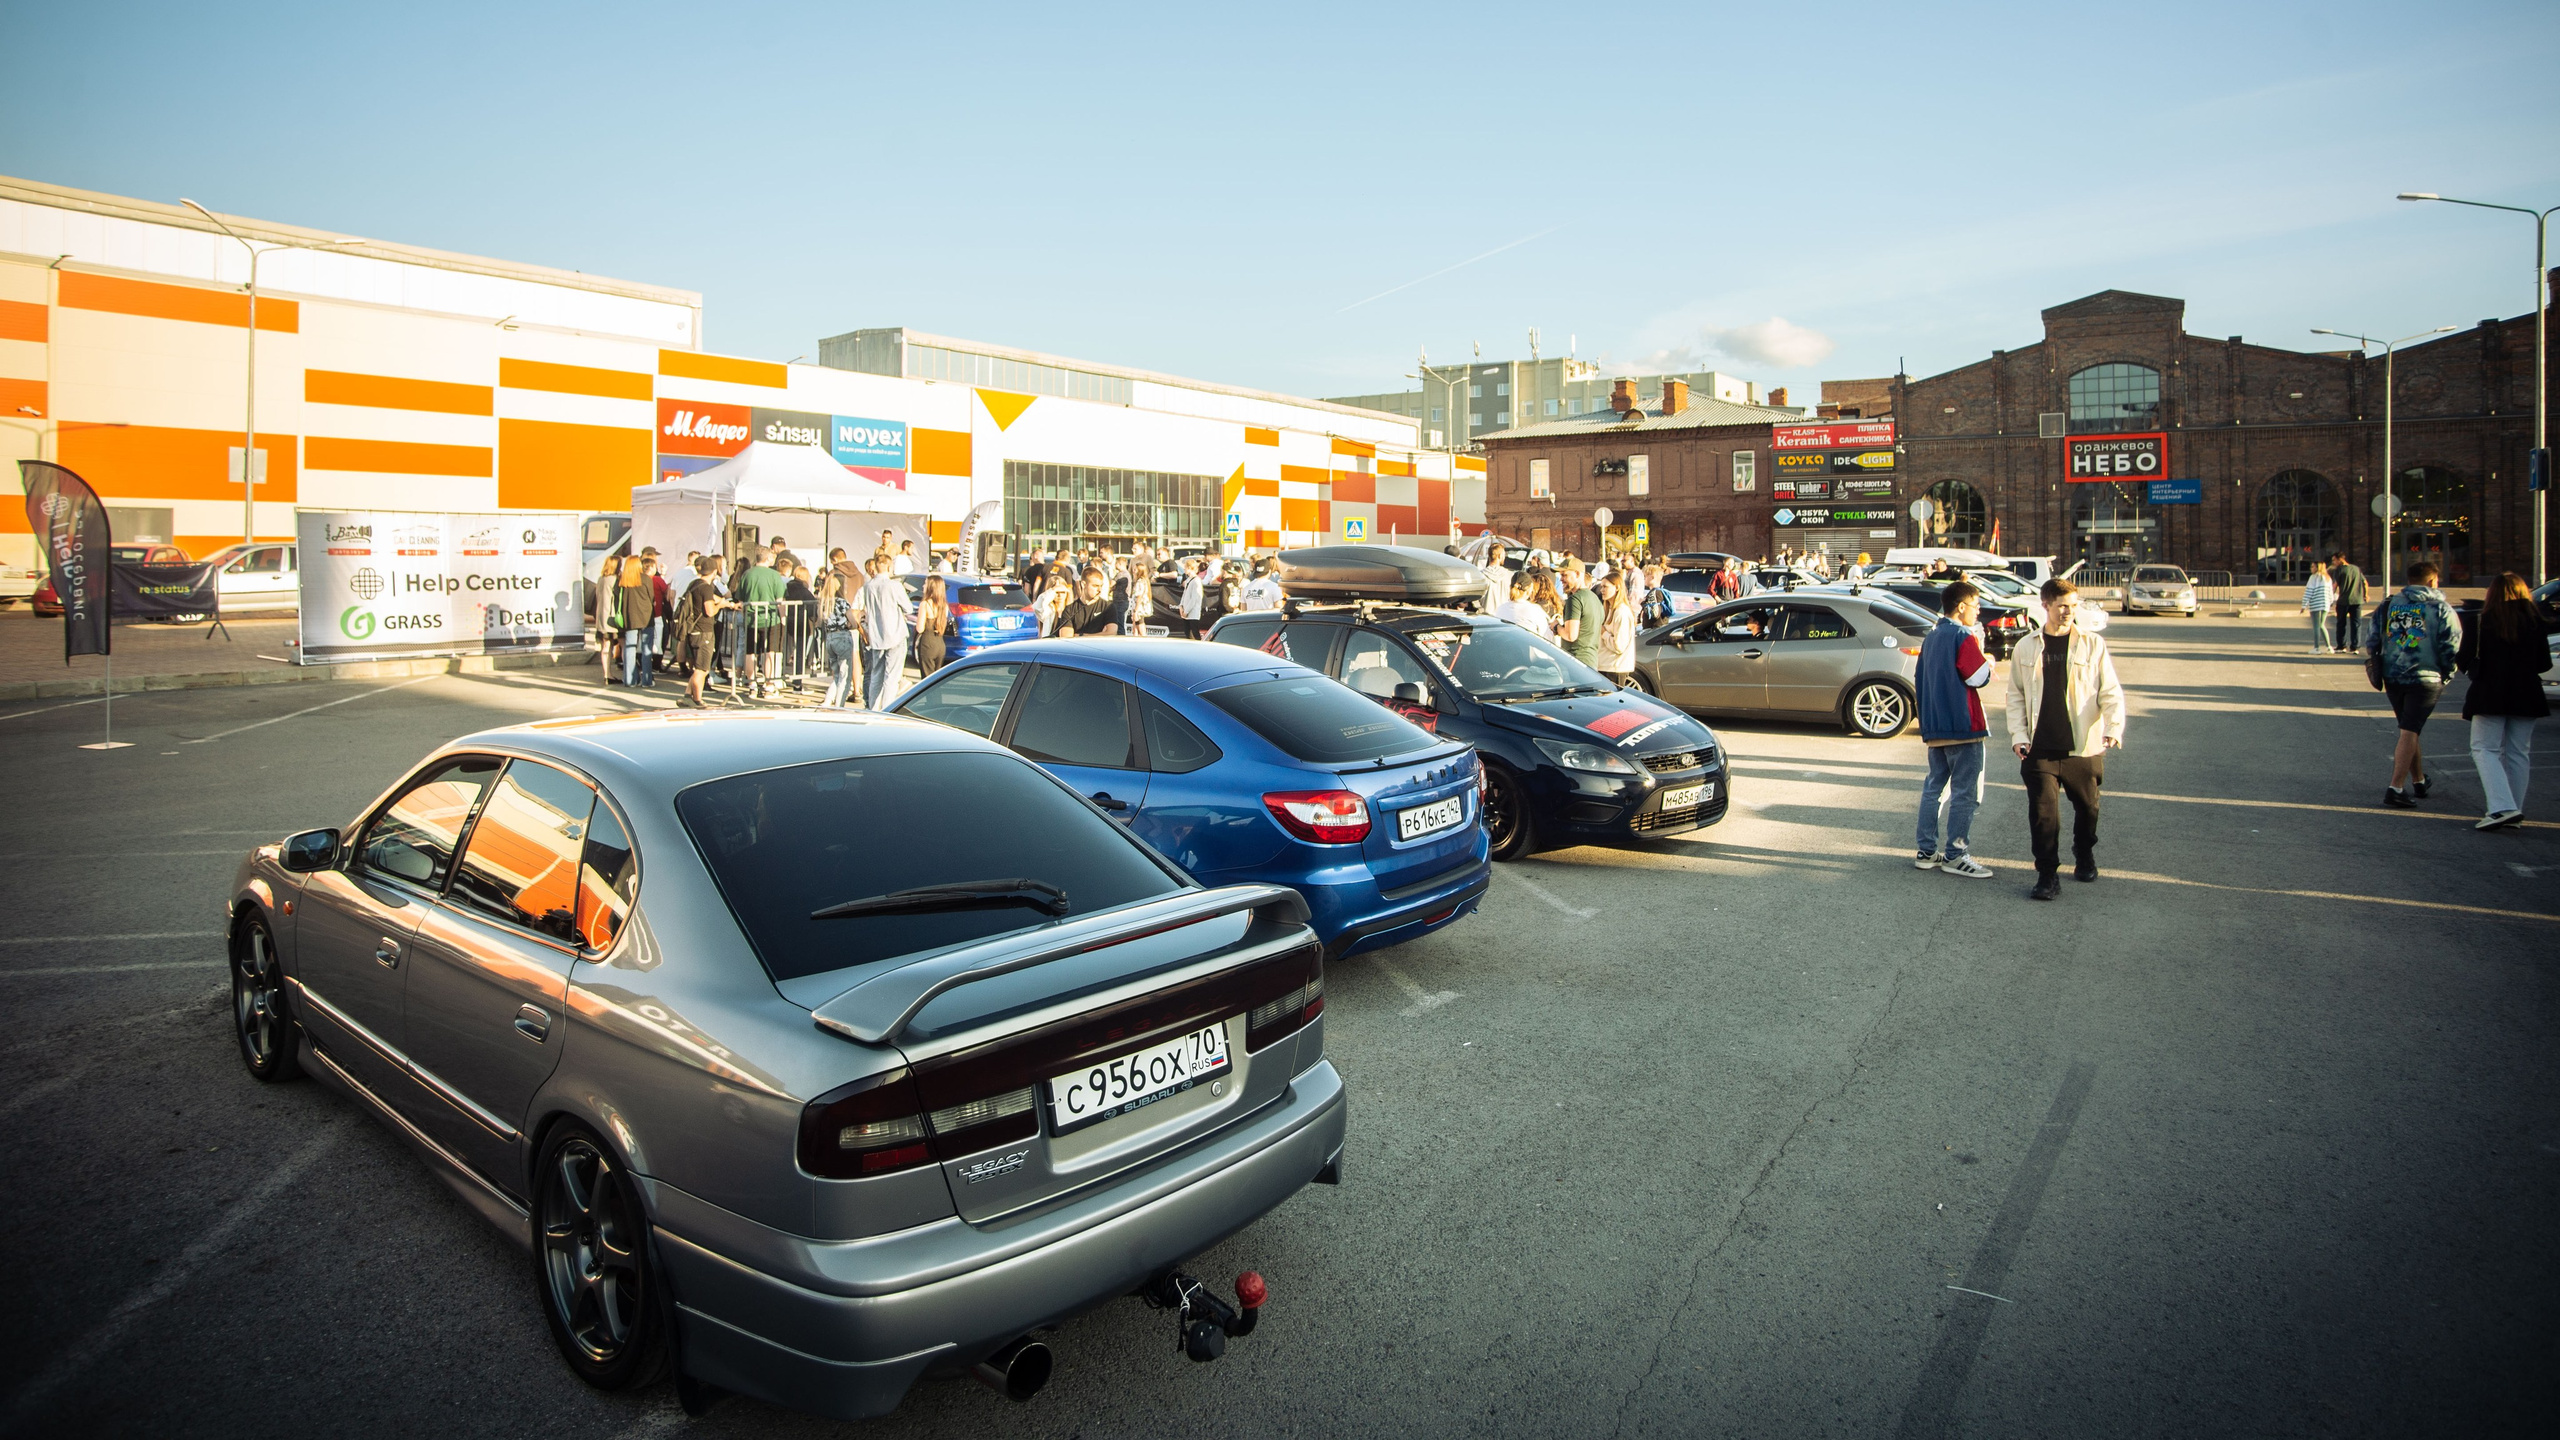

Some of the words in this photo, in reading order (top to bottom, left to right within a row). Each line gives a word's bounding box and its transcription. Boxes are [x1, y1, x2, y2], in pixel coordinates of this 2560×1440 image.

[664, 410, 748, 445] М.видео
[765, 420, 822, 447] sinsay
[1857, 424, 1891, 432] ПЛИТКА
[1777, 434, 1832, 447] Keramik
[1839, 435, 1892, 444] САНТЕХНИКА
[2074, 441, 2154, 454] оранжевое
[1862, 454, 1893, 464] LIGHT
[2073, 452, 2157, 473] НЕБО
[1774, 482, 1796, 491] STEEL
[1774, 490, 1796, 499] GRILL
[1796, 509, 1829, 517] АЗБУКА
[1833, 511, 1866, 520] СТИЛЬ
[1866, 510, 1895, 520] КУХНИ
[406, 573, 460, 596] Help
[466, 573, 542, 591] Center
[384, 614, 443, 630] GRASS
[499, 608, 555, 627] Detail
[1412, 766, 1458, 785] LADA
[1701, 784, 1712, 797] 196
[1446, 800, 1459, 817] 142
[1189, 1028, 1216, 1061] 70
[1191, 1057, 1211, 1073] RUS
[1124, 1087, 1176, 1113] SUBARU
[957, 1149, 1030, 1177] LEGACY
